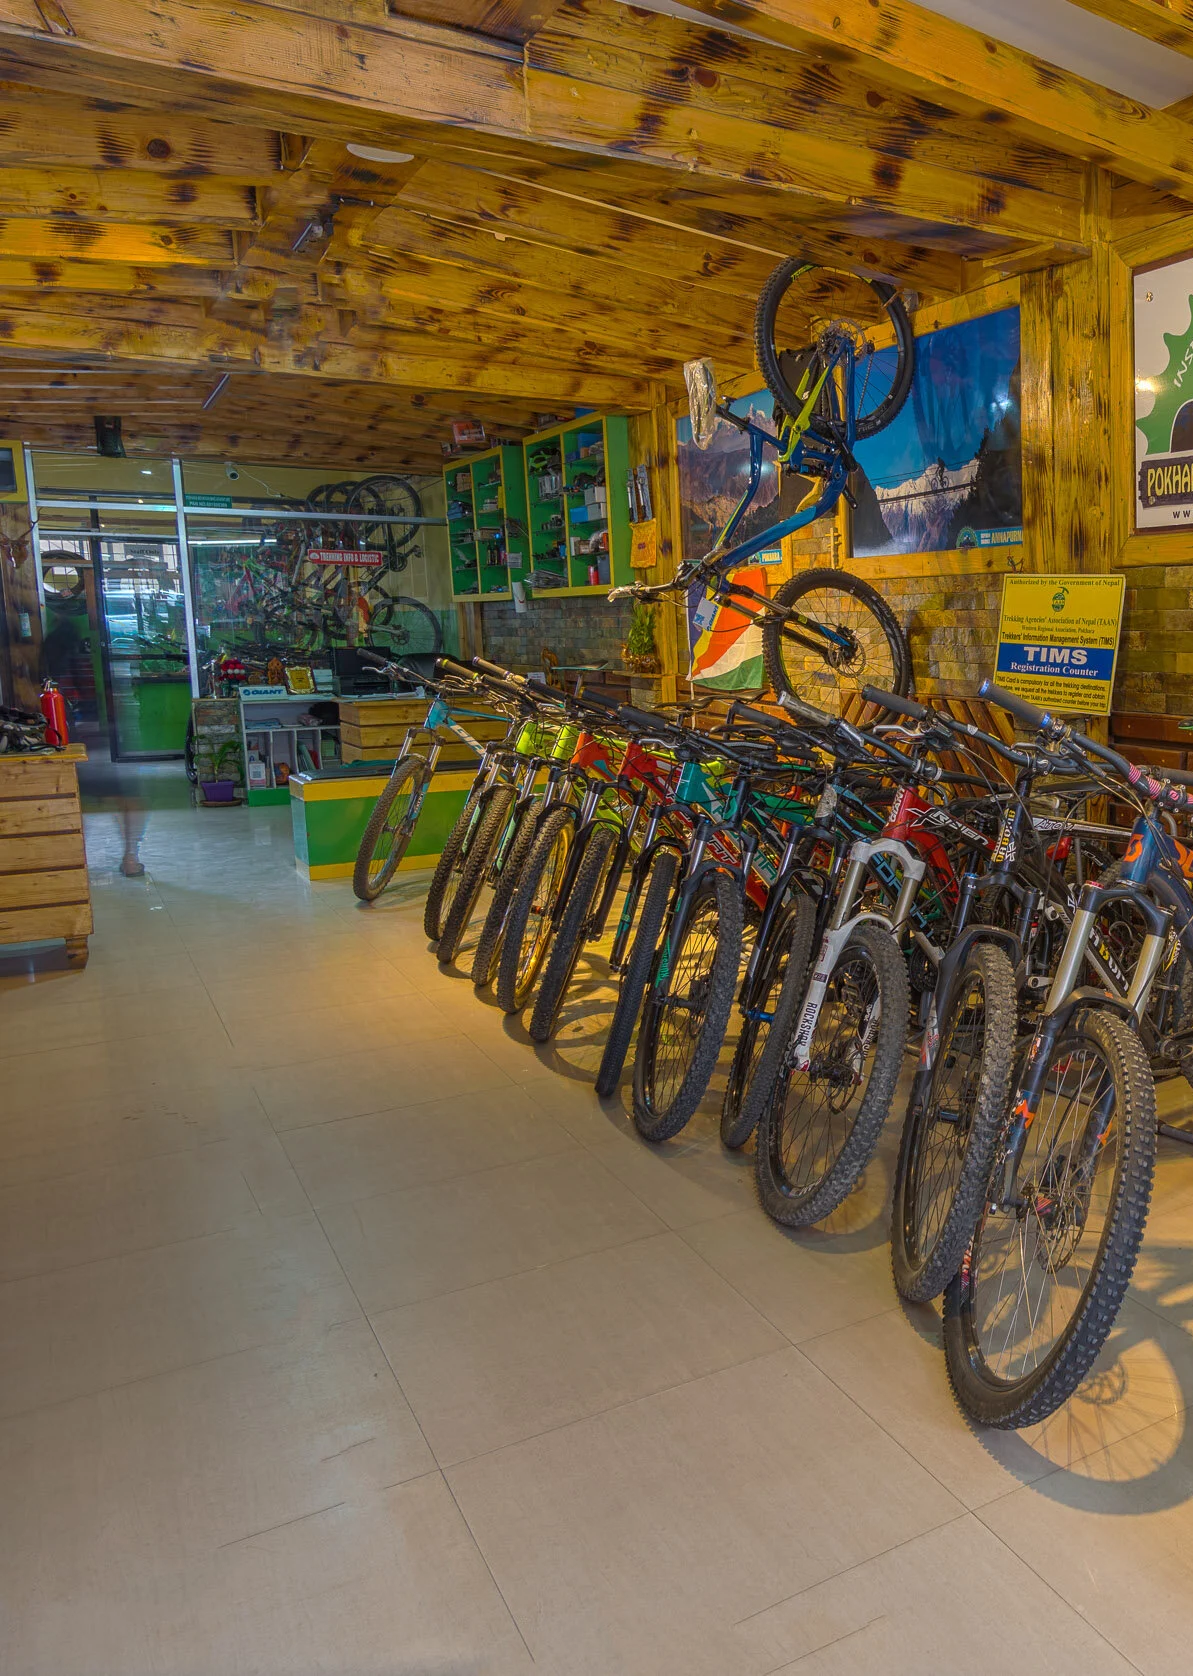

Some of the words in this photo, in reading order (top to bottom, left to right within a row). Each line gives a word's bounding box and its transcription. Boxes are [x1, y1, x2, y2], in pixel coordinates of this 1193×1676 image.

[991, 530, 1023, 544] ANNAPURN
[1023, 646, 1088, 665] TIMS
[1010, 662, 1060, 674] Registration
[1062, 666, 1098, 677] Counter
[889, 783, 906, 823] GIANT
